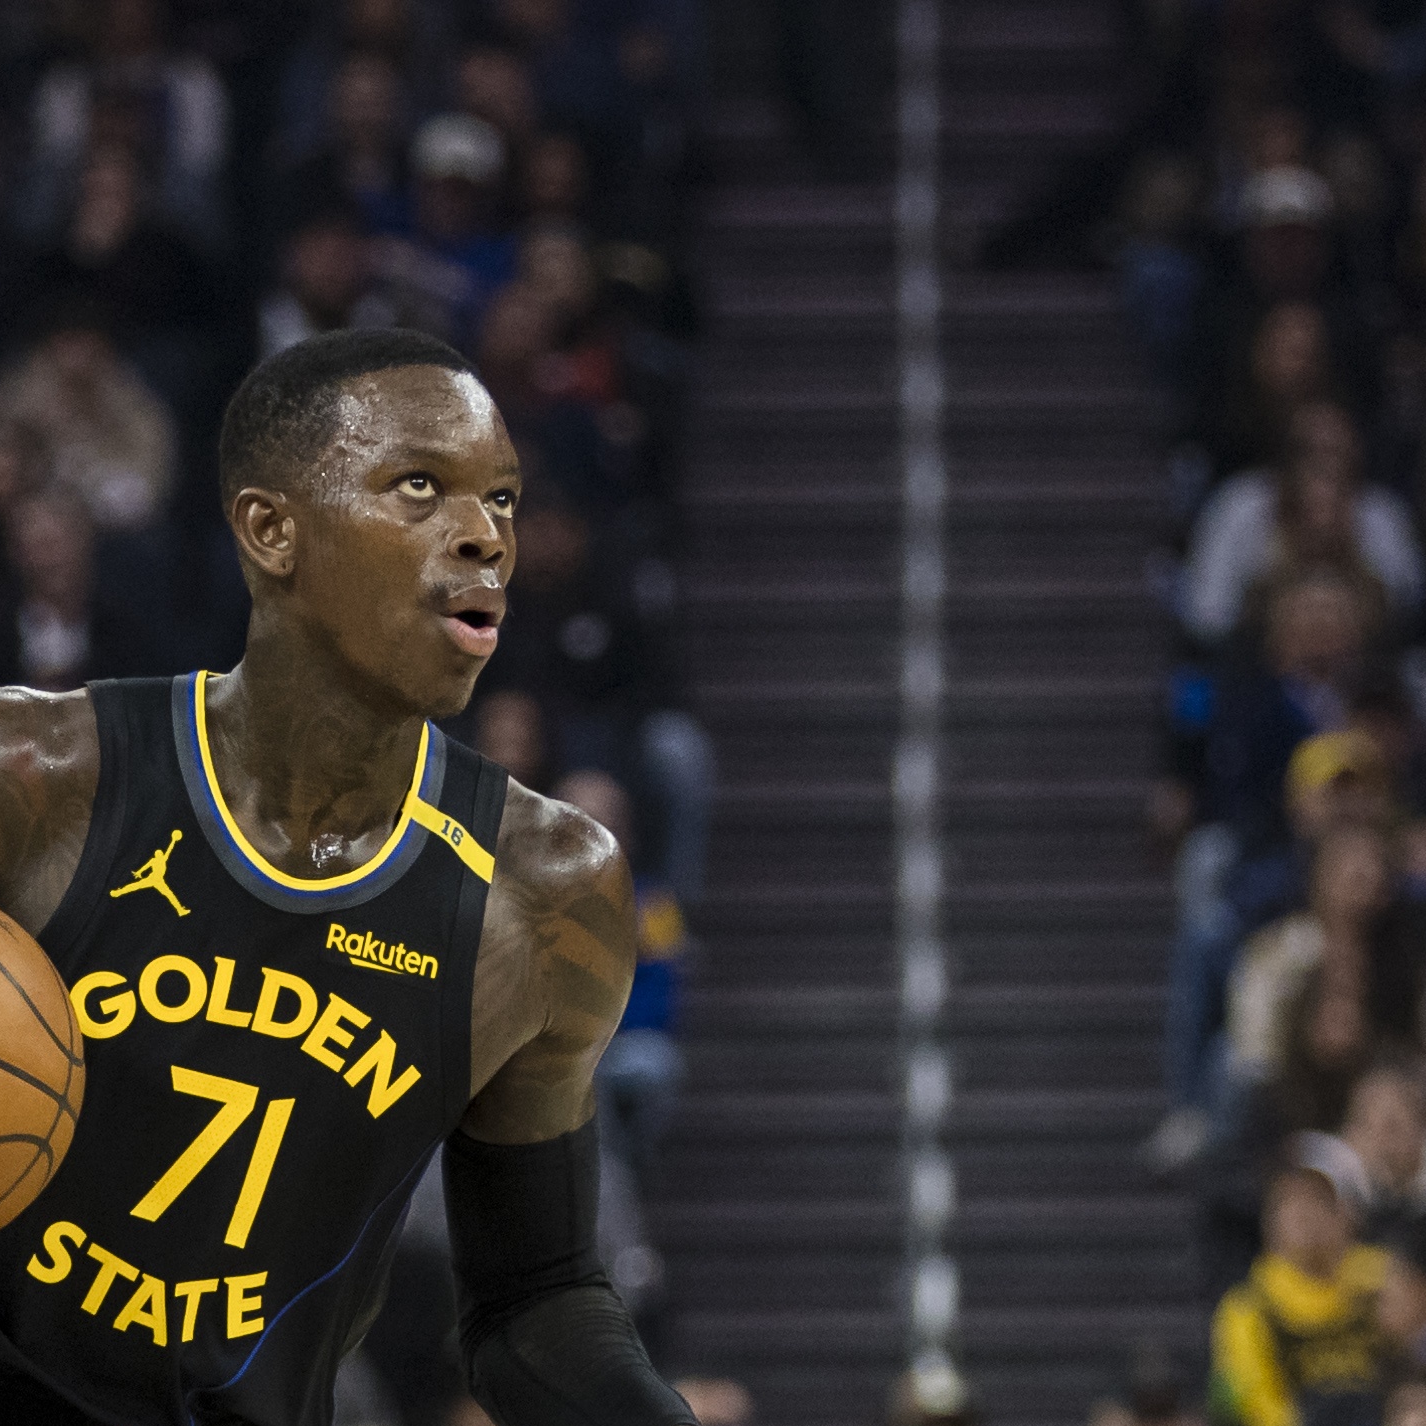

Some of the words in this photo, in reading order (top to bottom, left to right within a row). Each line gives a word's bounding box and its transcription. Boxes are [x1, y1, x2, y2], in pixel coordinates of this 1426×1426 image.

[441, 819, 464, 847] 16
[326, 923, 438, 979] Rakuten
[68, 954, 422, 1119] GOLDEN
[129, 1064, 296, 1249] 71
[26, 1221, 269, 1347] STATE
